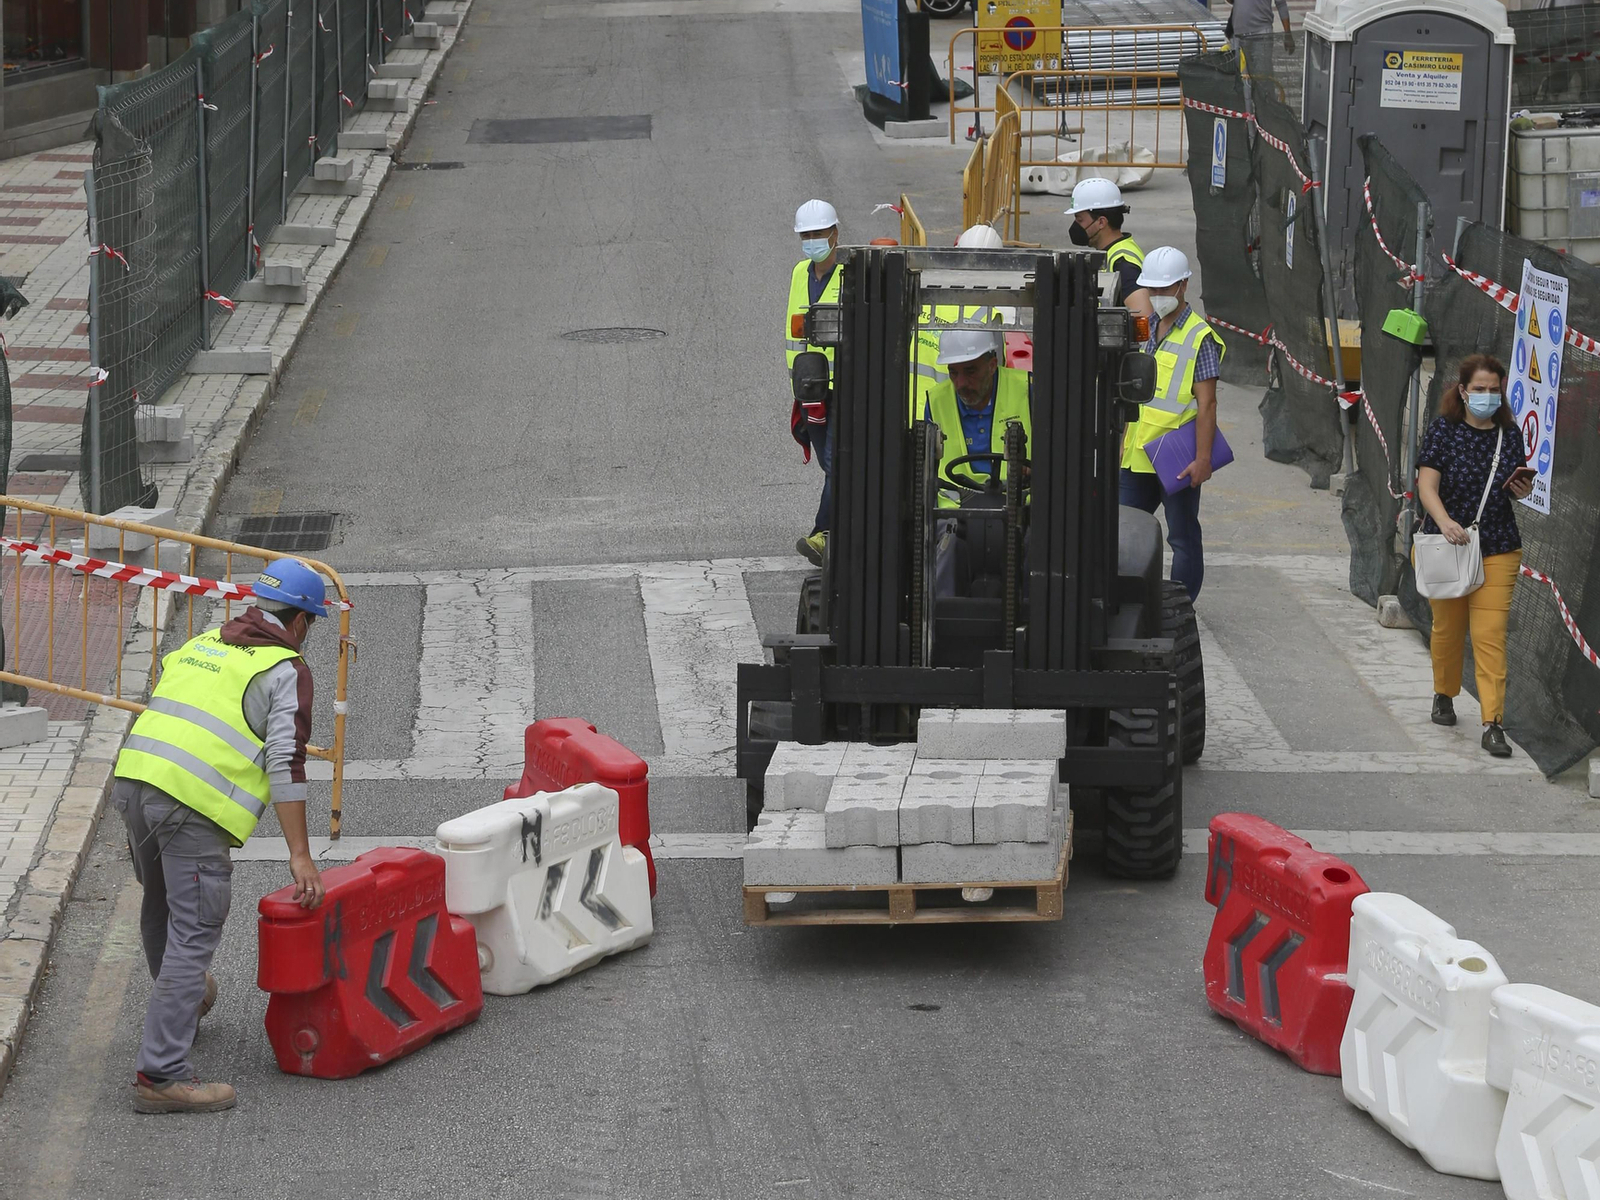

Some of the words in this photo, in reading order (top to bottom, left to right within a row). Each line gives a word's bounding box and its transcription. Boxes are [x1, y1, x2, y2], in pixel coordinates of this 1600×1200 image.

[1411, 55, 1454, 63] FERRETERIA
[1550, 280, 1564, 293] TODAS
[1537, 289, 1560, 305] SEGURIDAD
[1536, 479, 1547, 493] TODA
[1533, 494, 1545, 507] OBRA
[1547, 1043, 1600, 1092] SAFE
